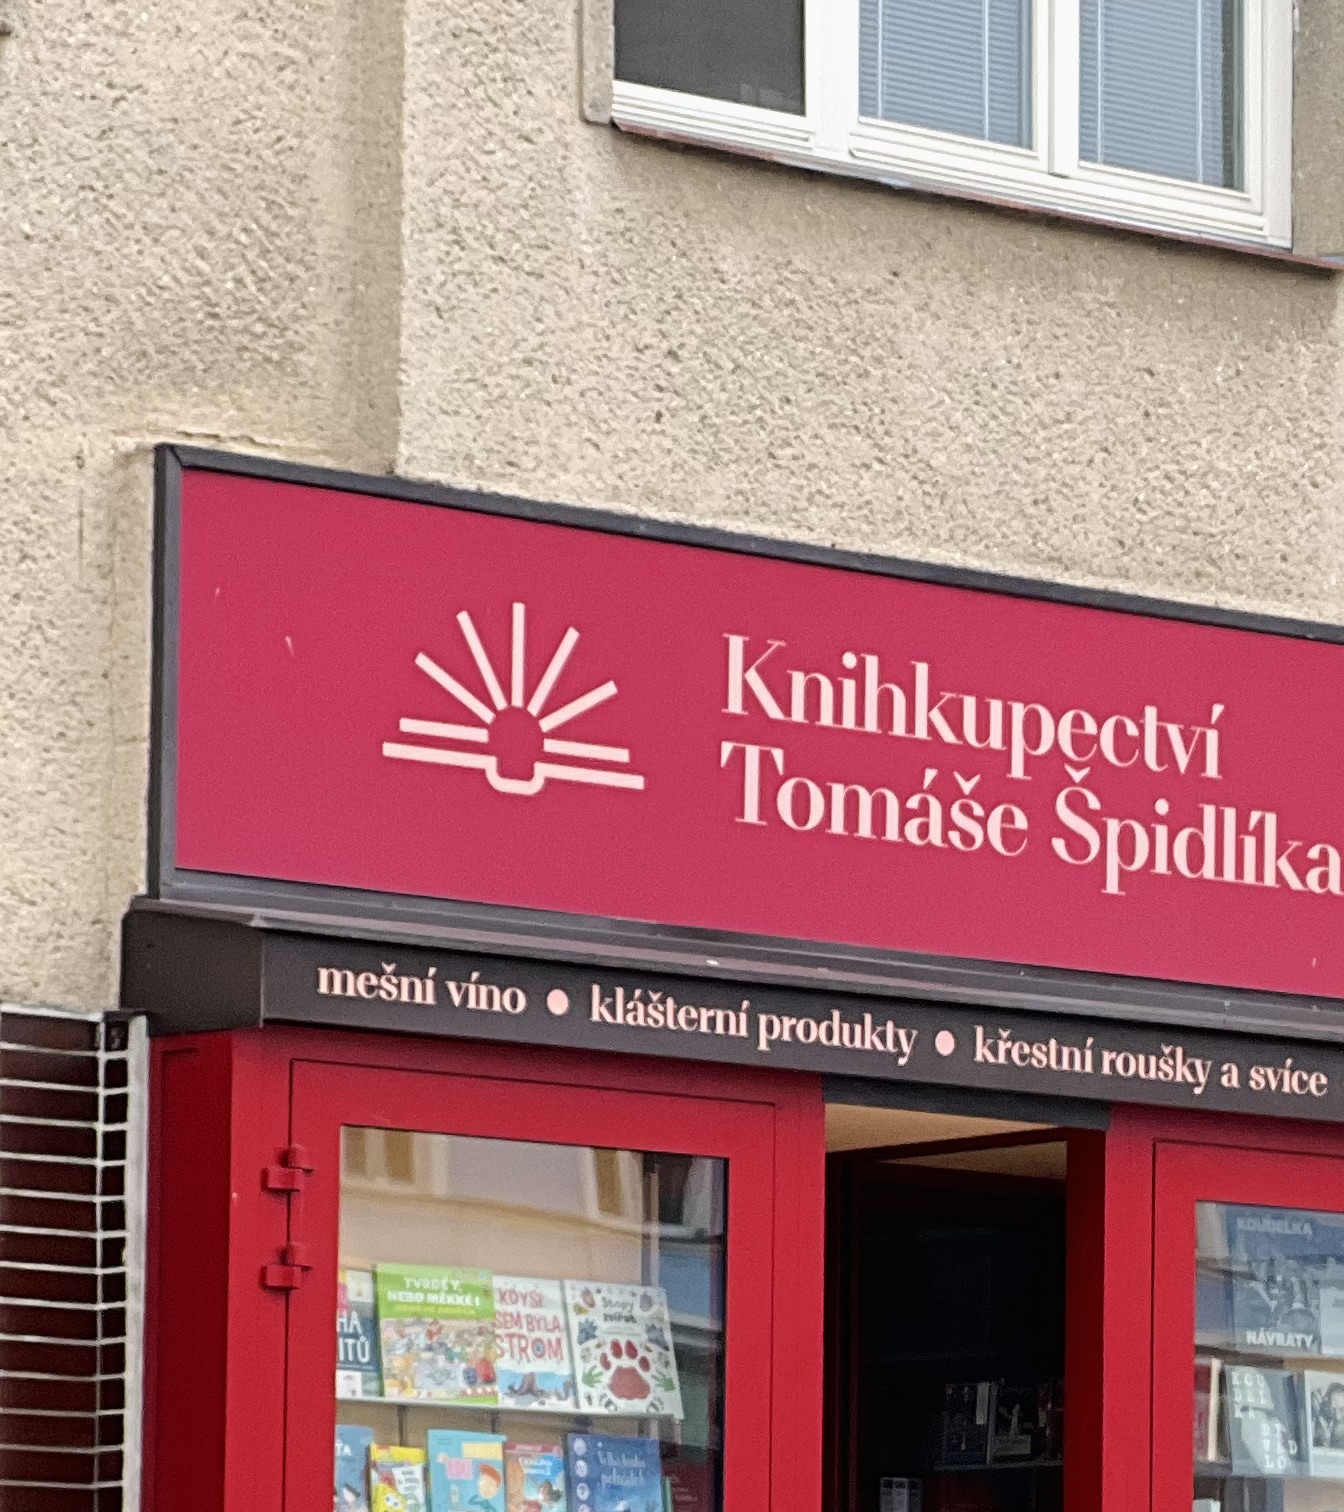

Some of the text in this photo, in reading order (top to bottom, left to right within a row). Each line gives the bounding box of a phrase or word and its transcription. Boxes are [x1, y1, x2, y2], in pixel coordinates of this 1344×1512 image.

[723, 632, 1226, 780] Knihkupectví
[720, 740, 1344, 896] Tomáše Špidlíka
[315, 965, 438, 1006] mešní
[444, 970, 528, 1017] víno
[589, 982, 751, 1039] klášterní
[757, 1012, 920, 1067] produkty
[972, 1023, 1095, 1076] křestní
[1097, 1044, 1214, 1096] roušky
[1220, 1061, 1242, 1090] a
[1248, 1056, 1329, 1099] svíce
[495, 1311, 522, 1329] SEM
